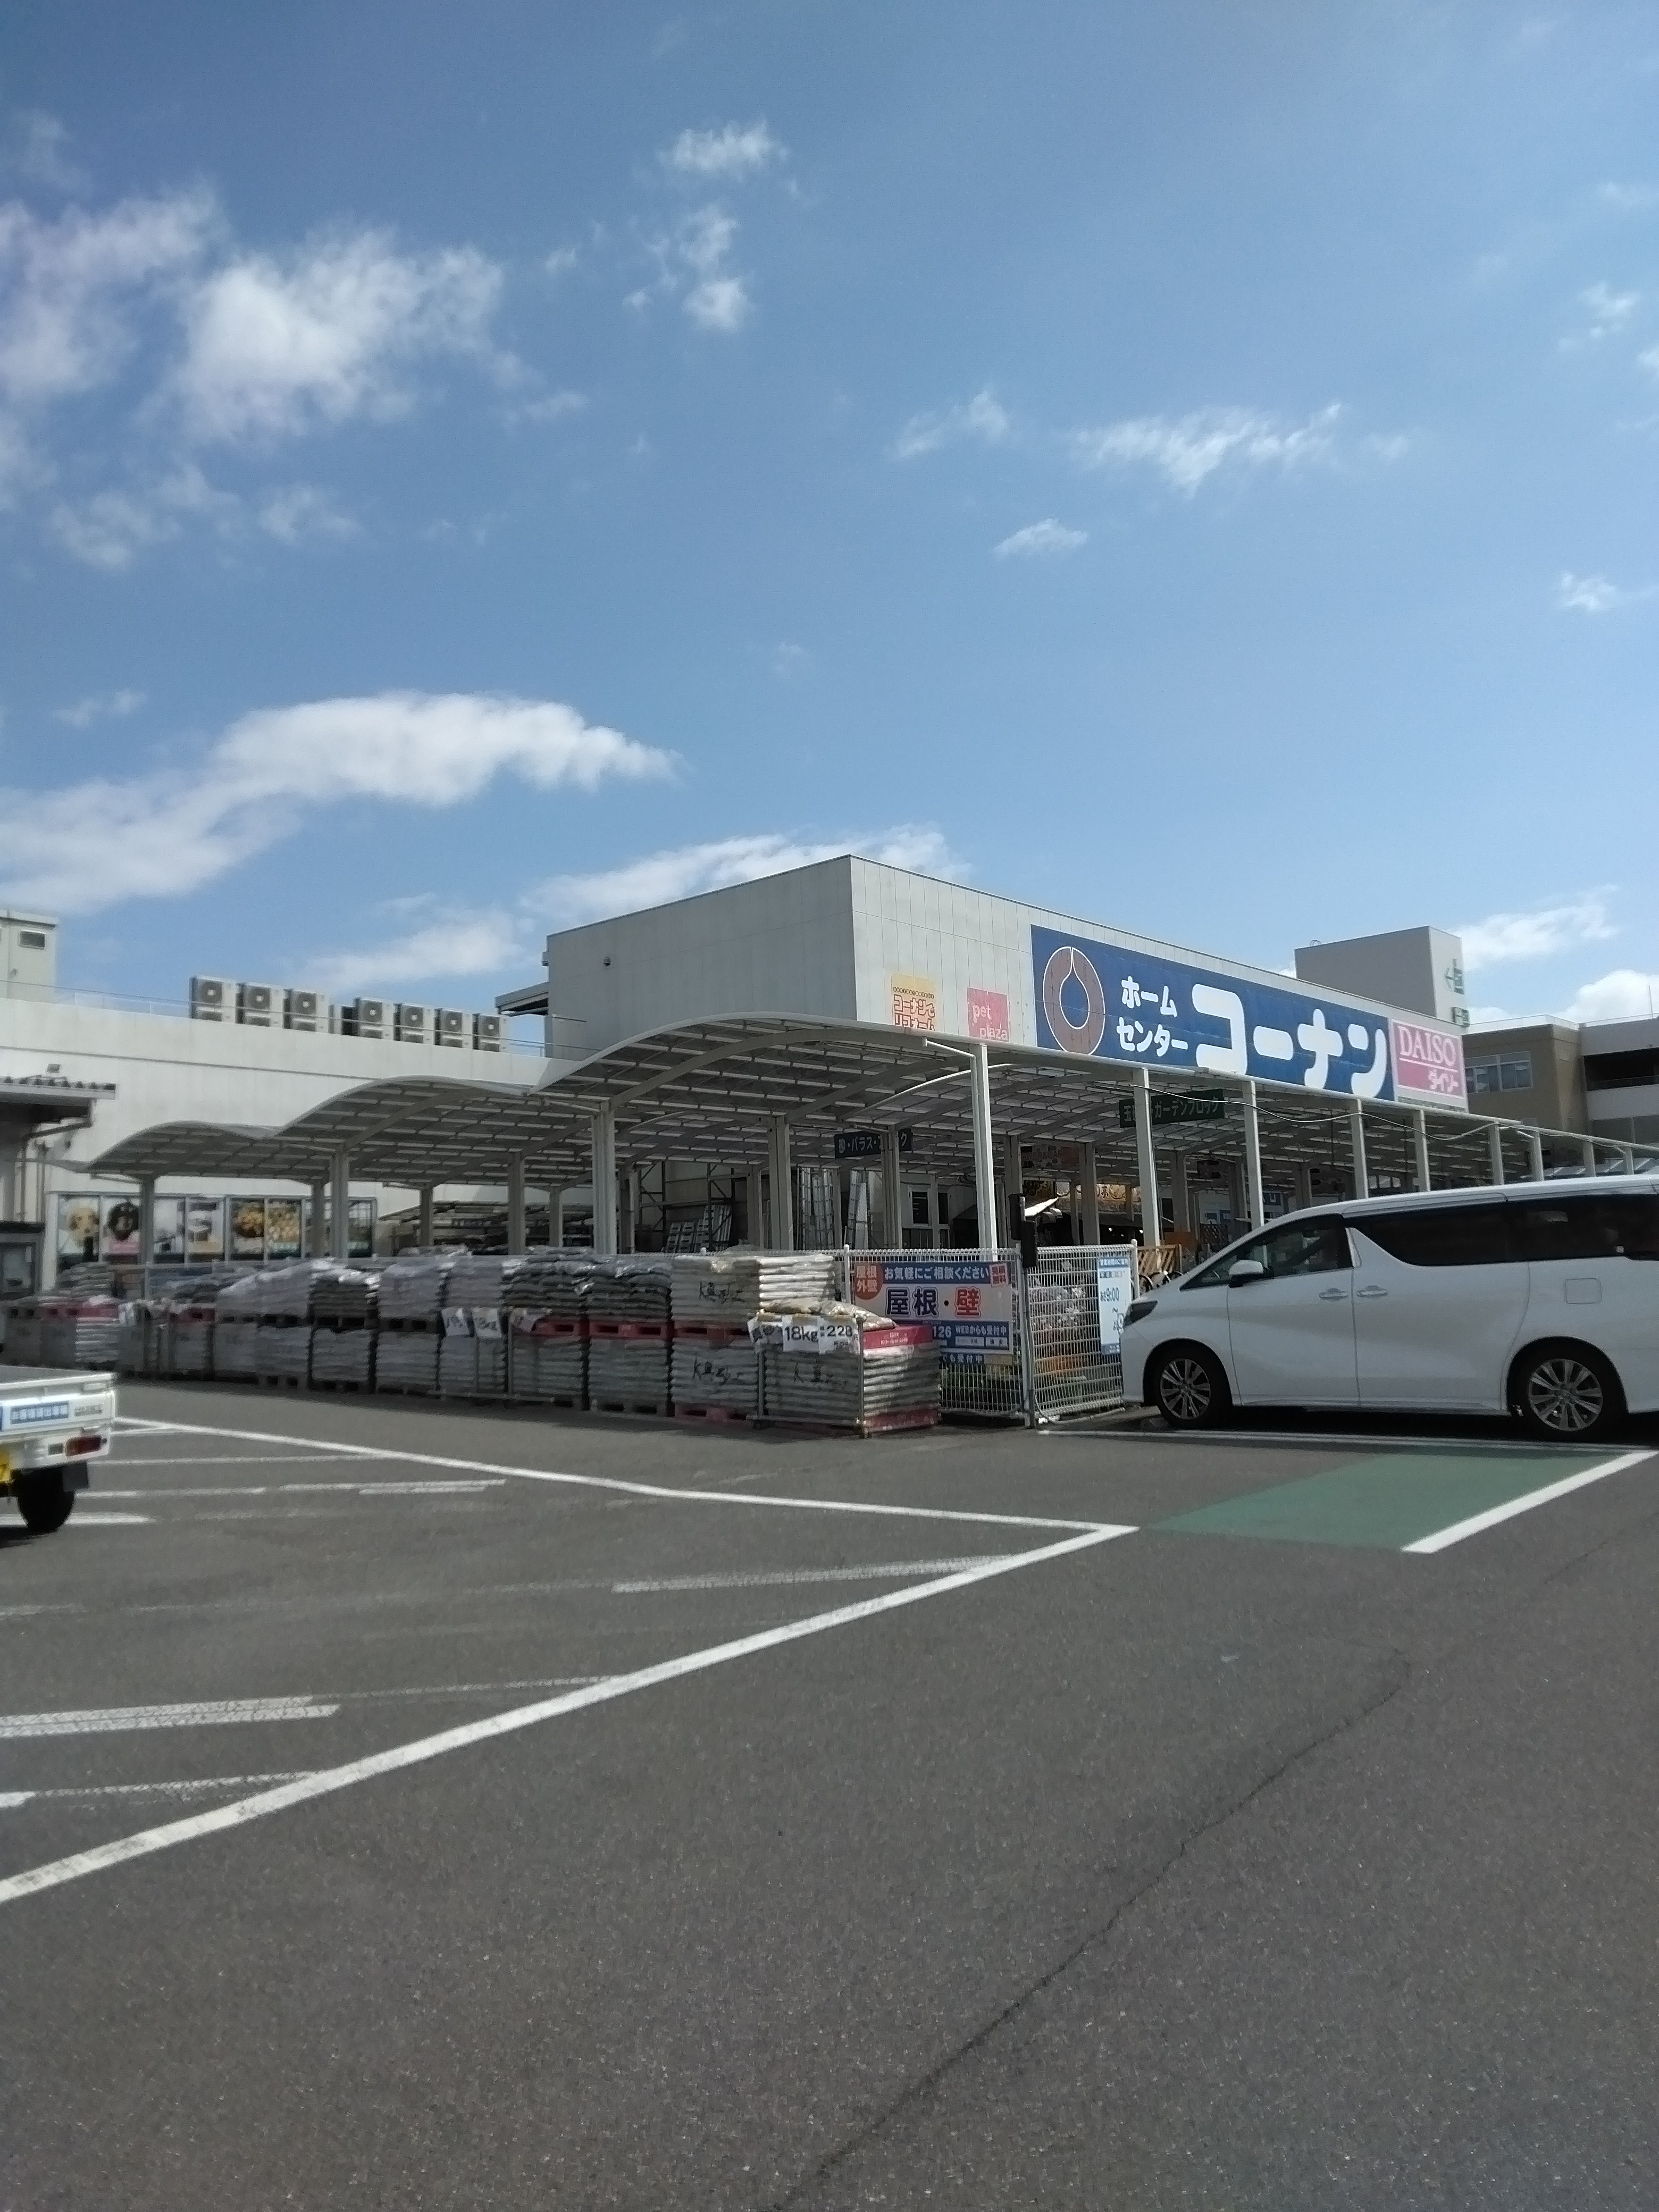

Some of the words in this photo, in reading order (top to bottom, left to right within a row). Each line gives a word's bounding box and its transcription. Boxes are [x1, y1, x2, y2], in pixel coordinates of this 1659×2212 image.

[894, 994, 935, 1018] コーナンで
[1121, 976, 1177, 1017] ホーム
[973, 1004, 991, 1023] pet
[979, 1023, 1008, 1041] plaza
[1117, 1017, 1188, 1057] センター
[1192, 984, 1386, 1097] コーナン
[1397, 1026, 1456, 1066] DAISO
[885, 1266, 989, 1280] お気軽にご相談ください
[784, 1326, 818, 1343] 18kg
